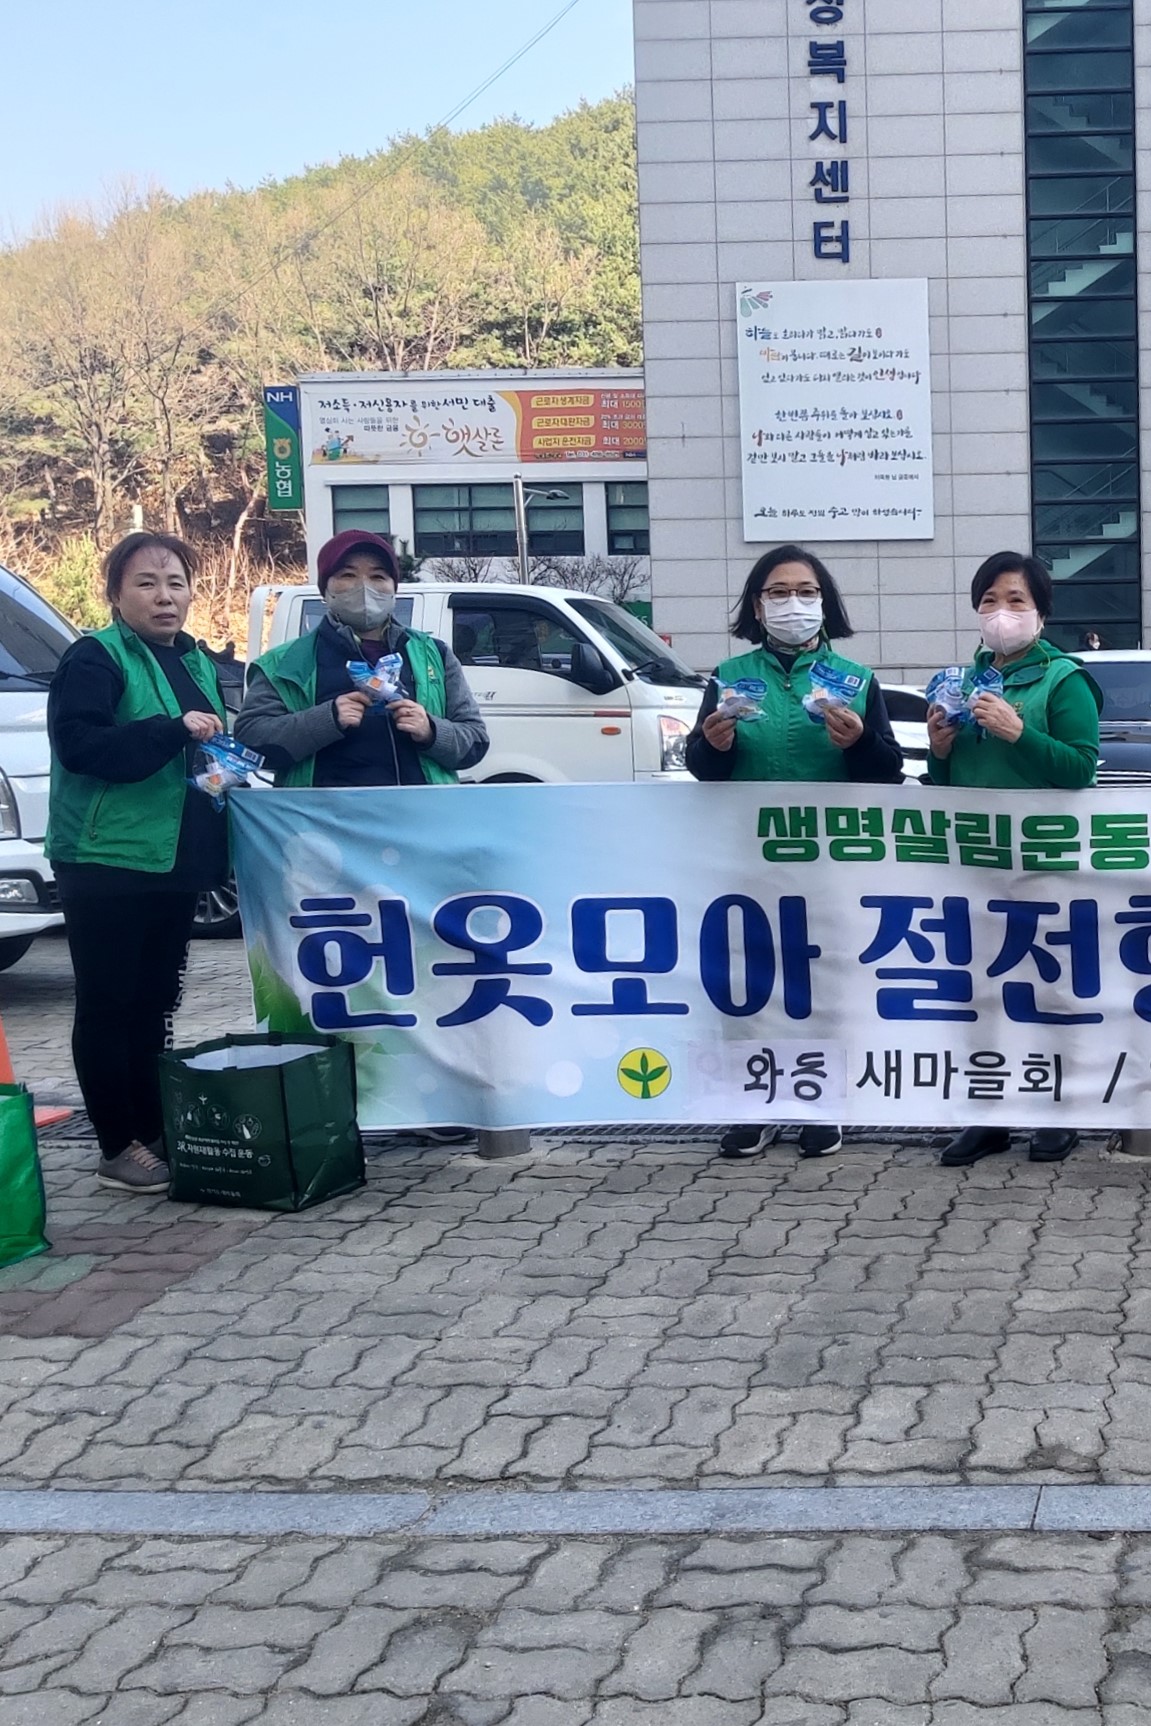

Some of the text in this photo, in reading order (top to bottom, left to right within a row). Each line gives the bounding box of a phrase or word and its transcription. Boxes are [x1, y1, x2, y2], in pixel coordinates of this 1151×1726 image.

[266, 391, 293, 403] NH
[443, 396, 469, 411] 서민
[474, 394, 497, 412] 대출
[441, 417, 504, 458] 햇살론
[275, 461, 293, 498] 농협
[757, 806, 1150, 872] 생명살림운동
[289, 894, 822, 1029] 헌옷모아
[855, 1049, 1062, 1102] 새마을회
[1102, 1052, 1127, 1104] /
